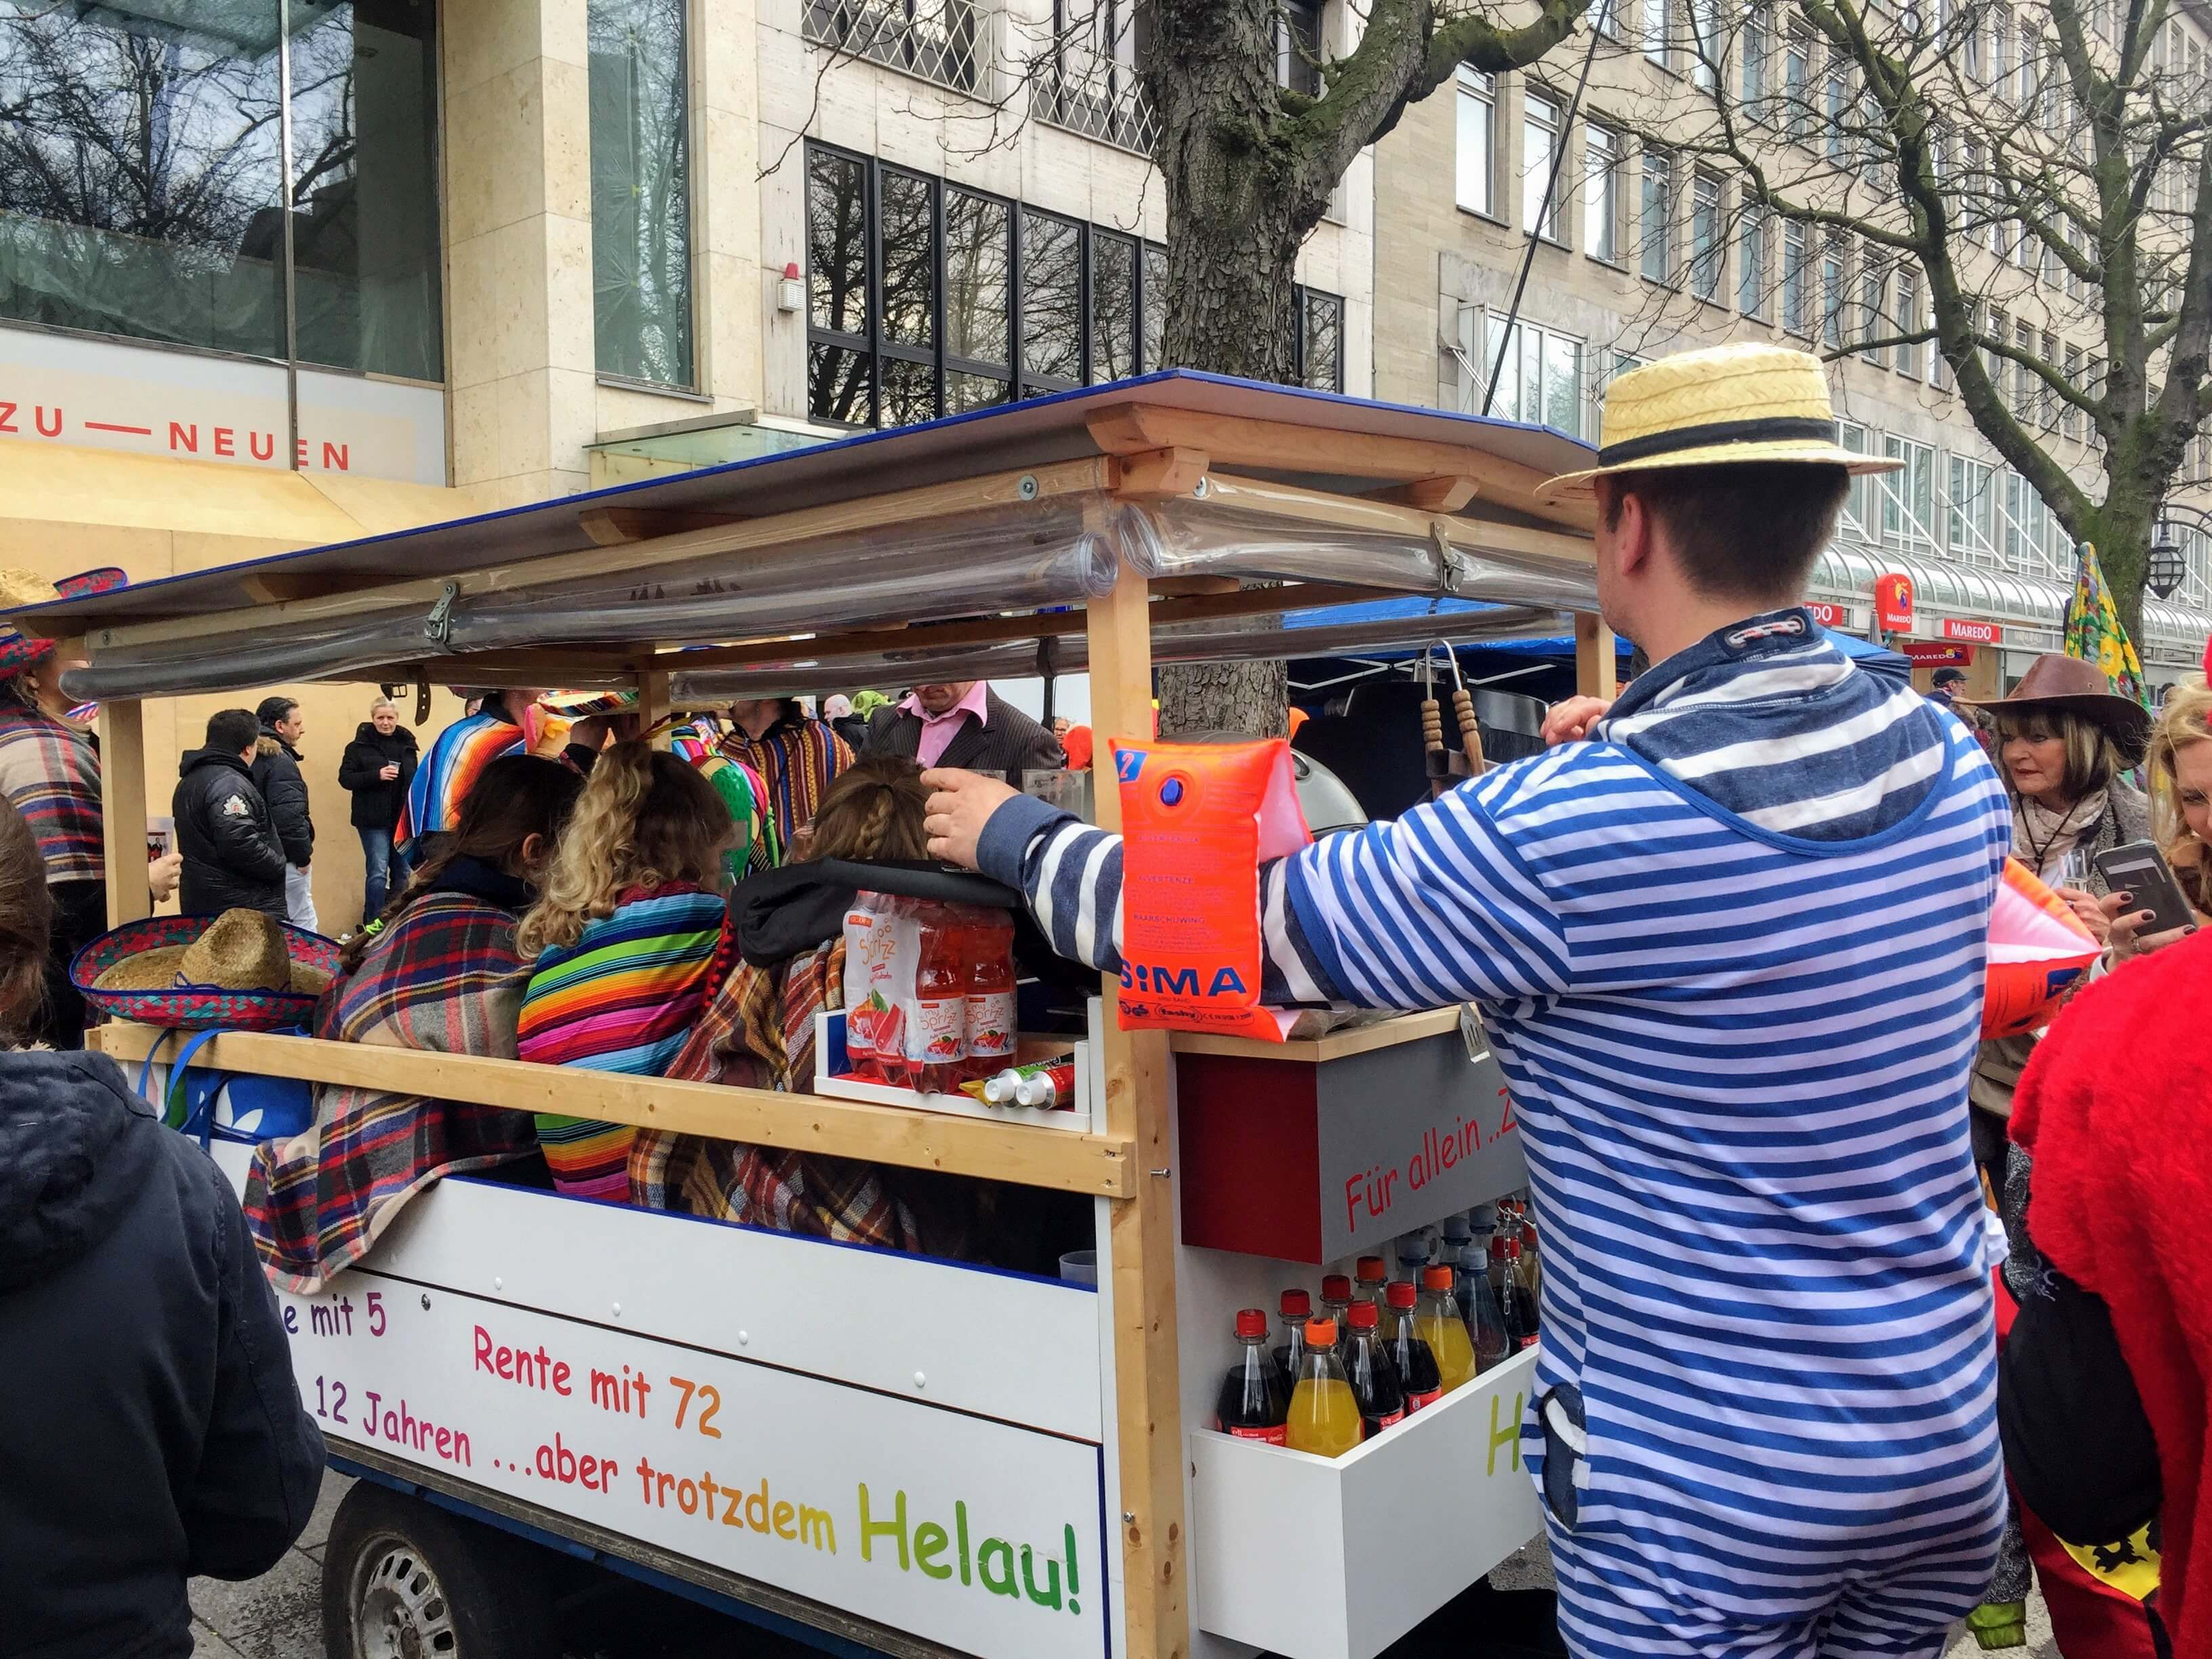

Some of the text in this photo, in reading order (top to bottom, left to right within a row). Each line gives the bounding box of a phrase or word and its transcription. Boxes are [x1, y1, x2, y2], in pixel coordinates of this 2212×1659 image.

[0, 402, 348, 471] ZU NEUEN
[1886, 613, 1912, 624] MAREDO
[1951, 621, 1992, 640] MAREDO
[1345, 1166, 1397, 1233] Für
[1409, 1116, 1481, 1191] allein
[311, 1293, 354, 1337] mit
[367, 1292, 386, 1337] 5
[474, 1324, 722, 1439] Rente mit 72
[316, 1375, 348, 1425] 12
[363, 1391, 471, 1467] Jahren
[636, 1456, 837, 1555] trotzdem
[859, 1482, 1082, 1616] Helau!
